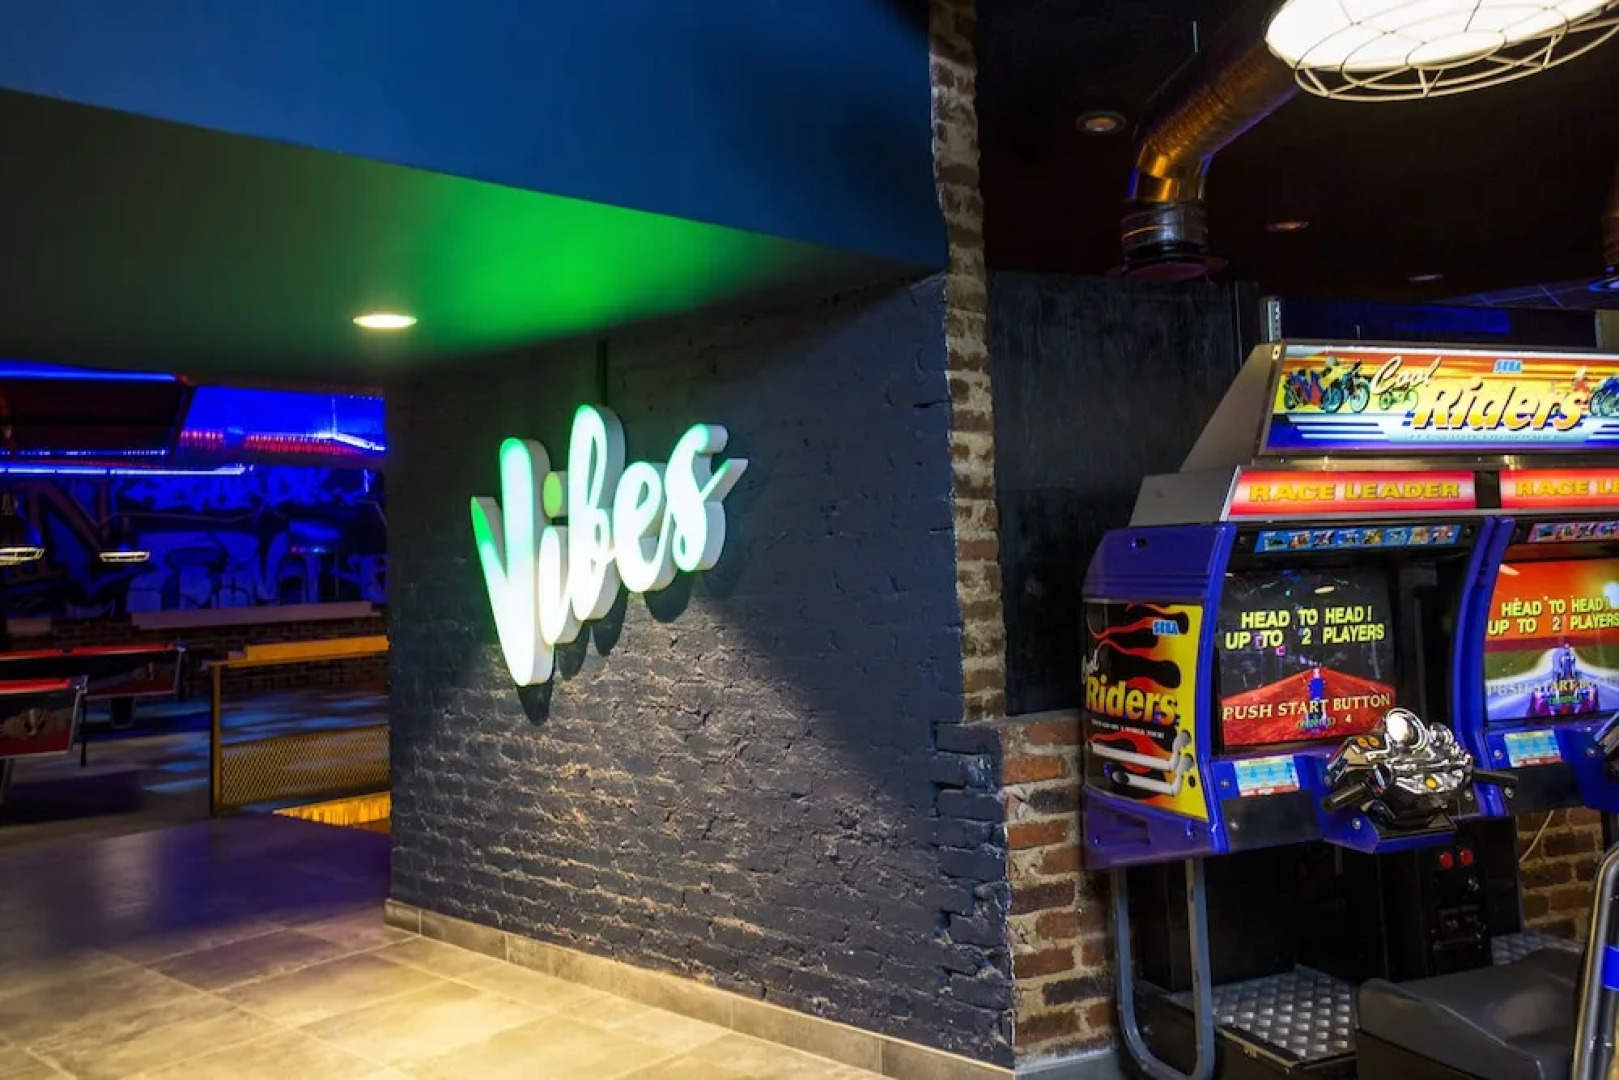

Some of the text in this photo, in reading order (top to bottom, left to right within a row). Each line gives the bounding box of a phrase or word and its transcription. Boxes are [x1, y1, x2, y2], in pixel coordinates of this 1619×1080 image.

[1369, 355, 1442, 398] Cool
[1412, 376, 1588, 431] Riders
[1250, 481, 1461, 502] RACE LEADER
[1515, 480, 1590, 497] RACE
[471, 404, 749, 687] Vibes
[1241, 610, 1290, 629] HEAD
[1297, 608, 1318, 626] TO
[1501, 601, 1542, 618] HEAD
[1548, 599, 1567, 615] TO
[1487, 611, 1619, 636] UP TO 2 PLAYERS
[1225, 624, 1385, 649] UP TO 2 PLAYERS
[1086, 674, 1177, 726] Riders
[1223, 692, 1390, 721] PUSH START BUTTON
